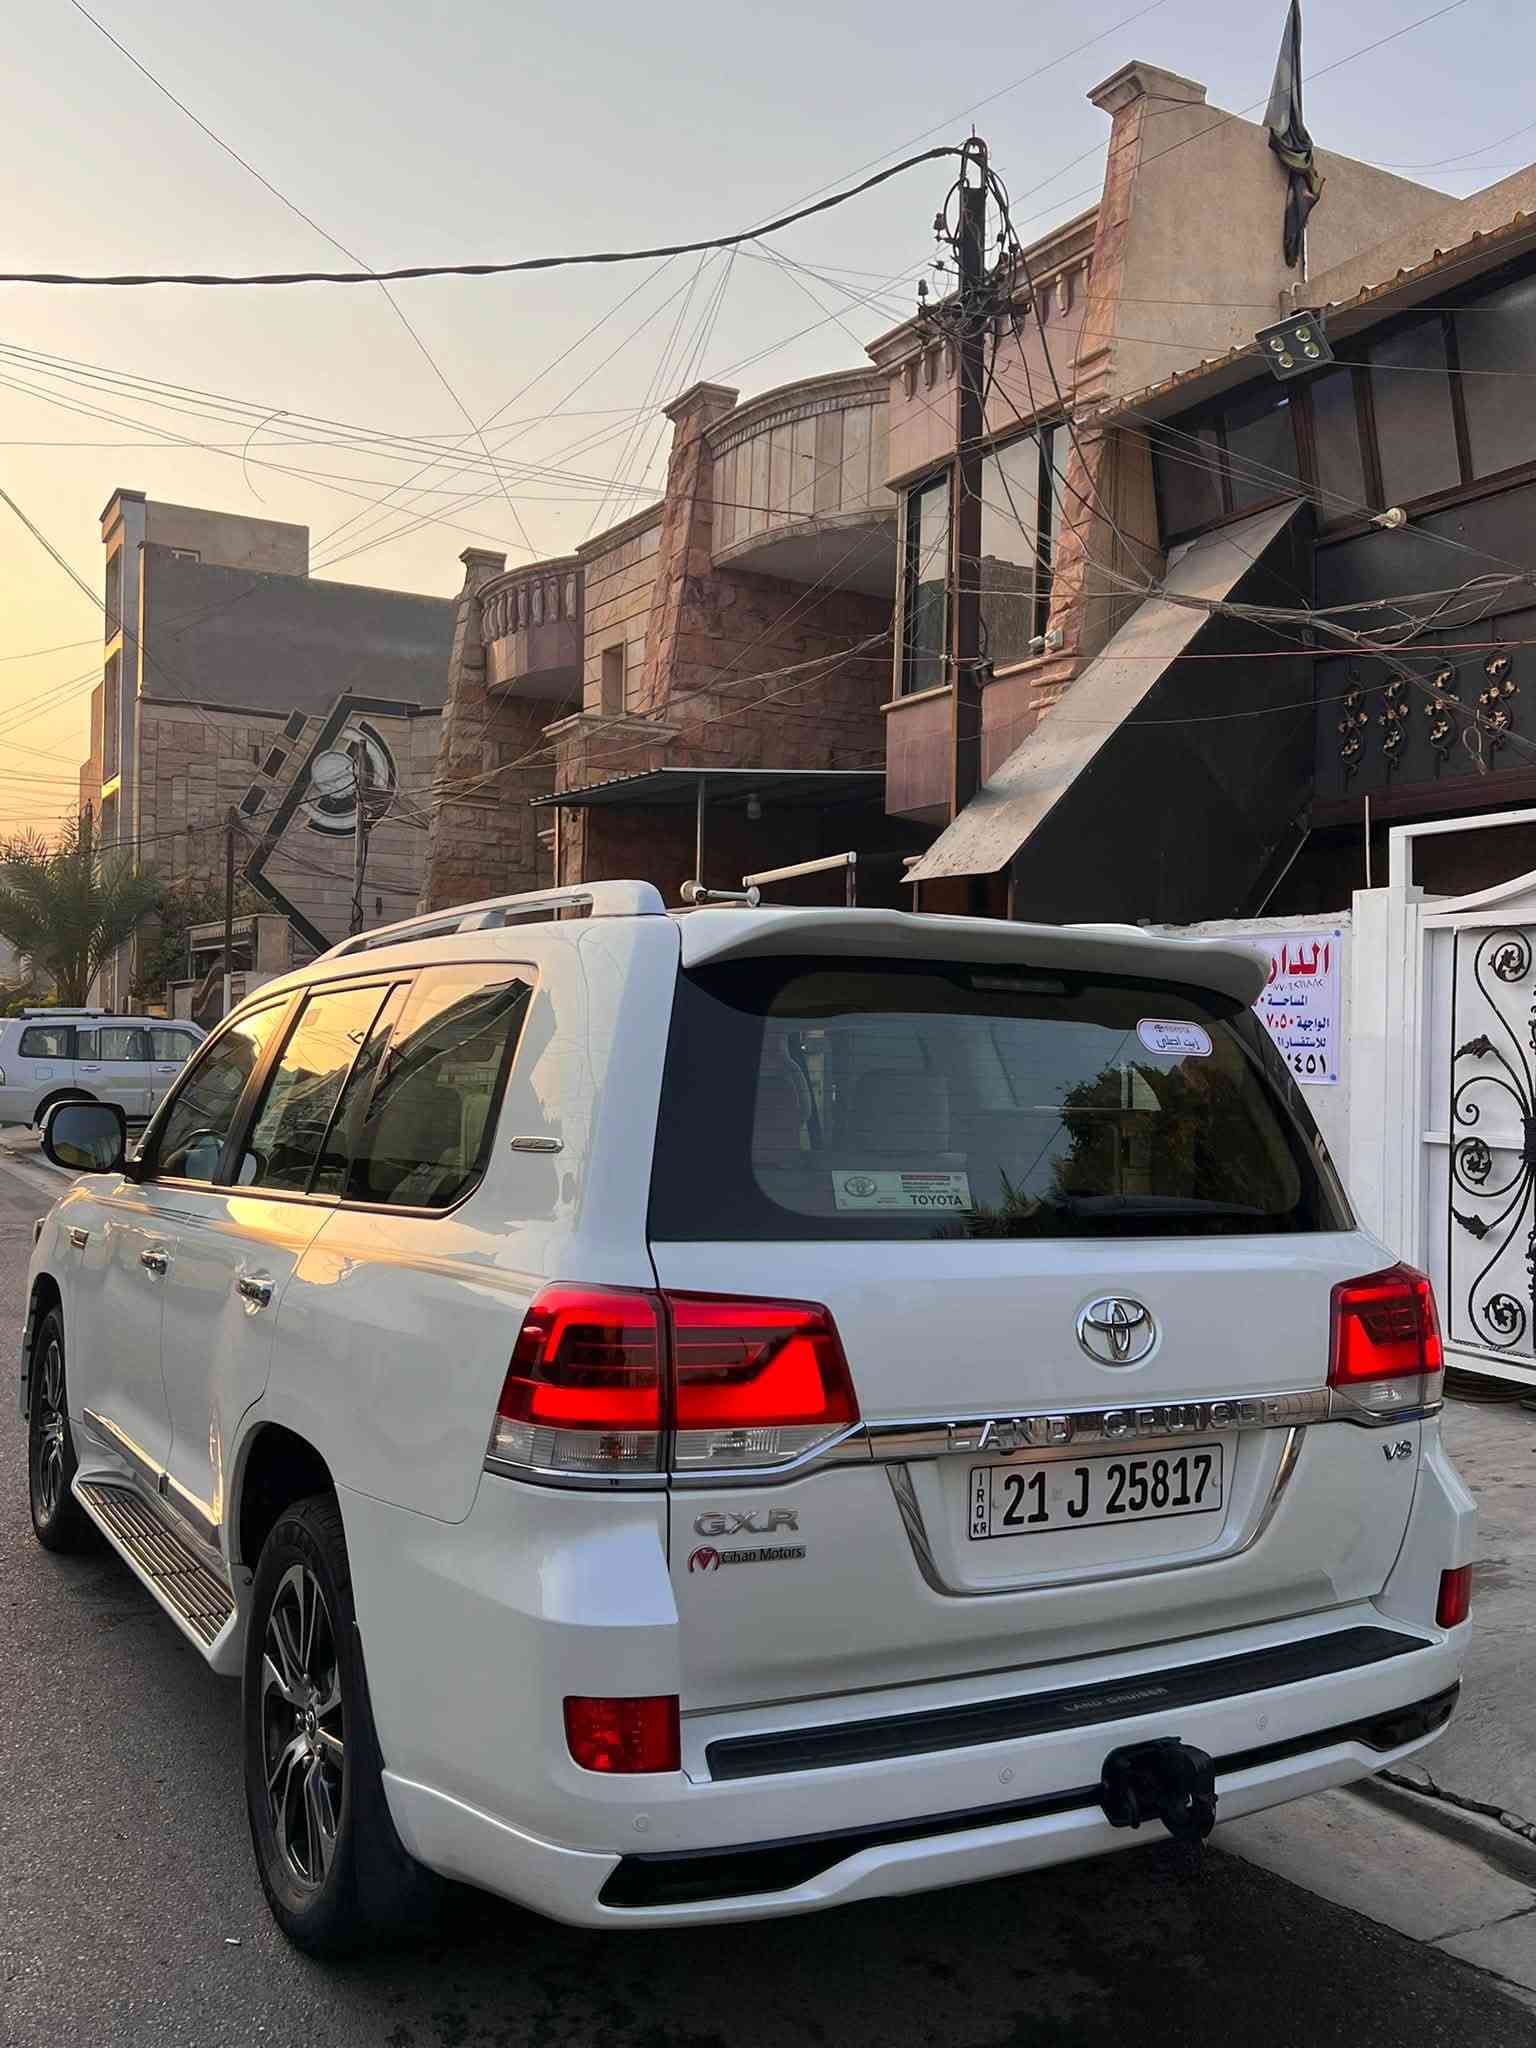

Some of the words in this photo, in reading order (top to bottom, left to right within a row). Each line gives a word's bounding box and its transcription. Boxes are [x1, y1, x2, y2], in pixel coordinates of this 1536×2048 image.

[1296, 1015, 1330, 1032] الواجهة
[910, 1194, 963, 1206] TOYOTA
[945, 1415, 1074, 1451] LAND
[1003, 1471, 1049, 1525] 21
[1067, 1467, 1089, 1518] J
[1106, 1454, 1212, 1514] 25817
[694, 1508, 799, 1536] GXR
[759, 1546, 802, 1561] Motors
